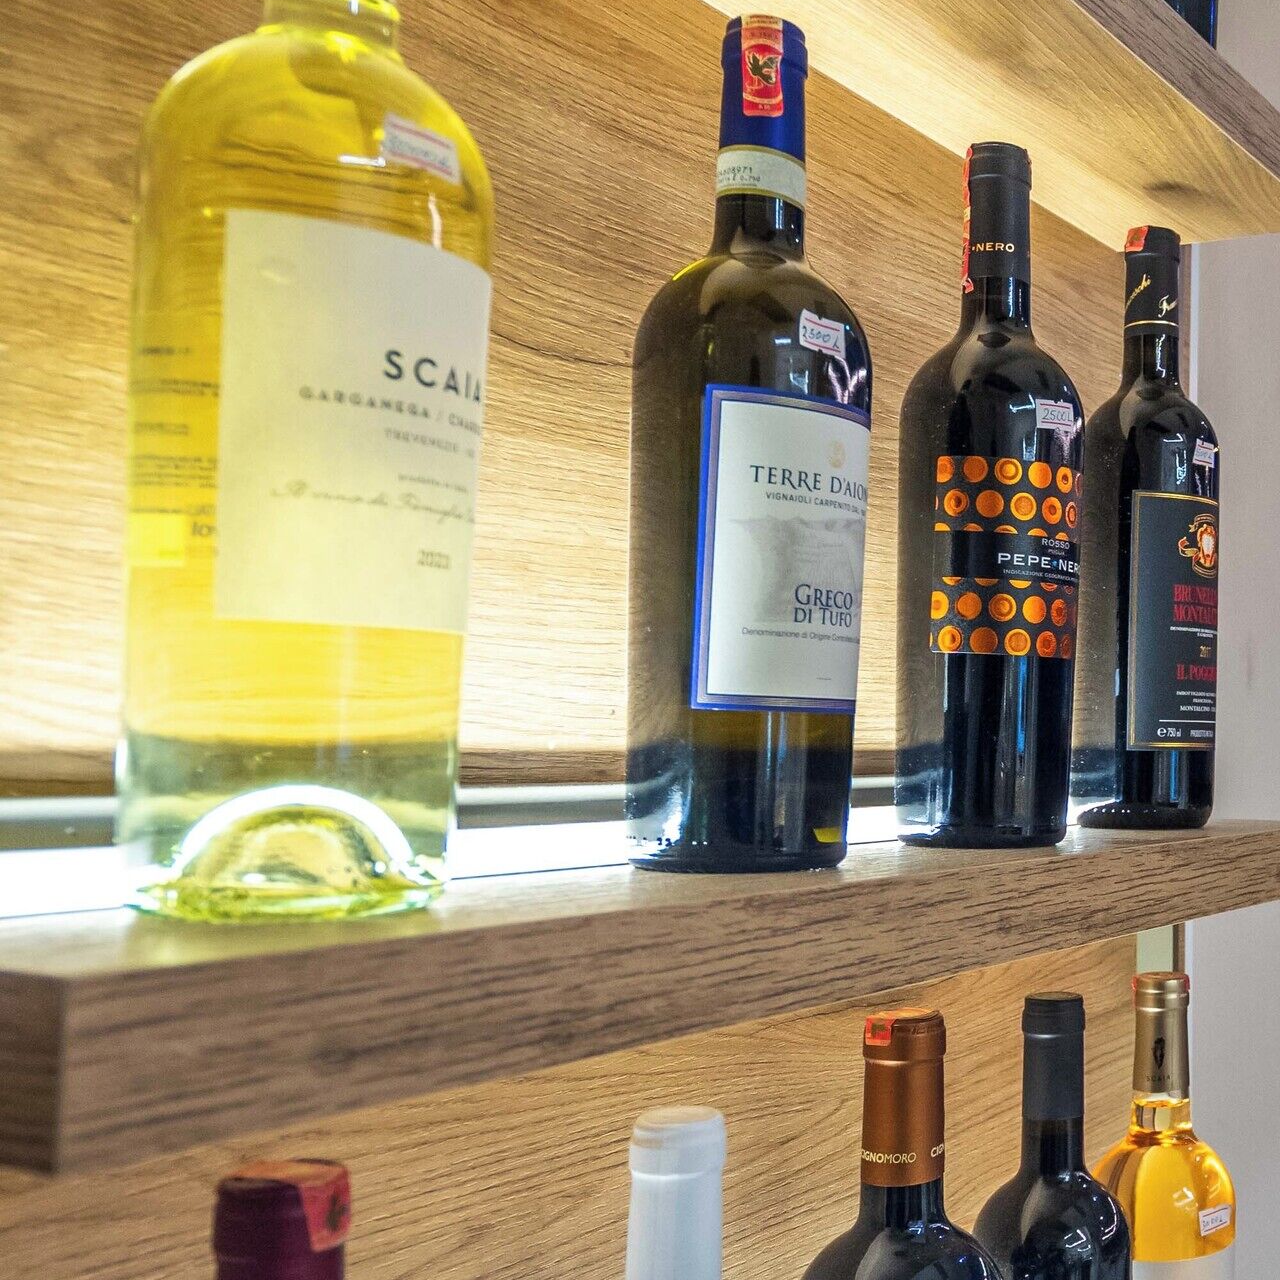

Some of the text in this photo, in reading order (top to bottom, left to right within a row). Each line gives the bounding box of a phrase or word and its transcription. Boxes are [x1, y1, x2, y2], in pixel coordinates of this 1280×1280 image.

[976, 242, 1015, 253] NERO
[383, 349, 482, 404] SCAIA
[750, 465, 822, 493] TERRE
[766, 491, 811, 505] VIGNAIOLI
[1041, 537, 1070, 550] ROSSO
[997, 552, 1051, 569] PEPE
[795, 583, 853, 610] GRECO
[794, 607, 852, 628] DI TUFO
